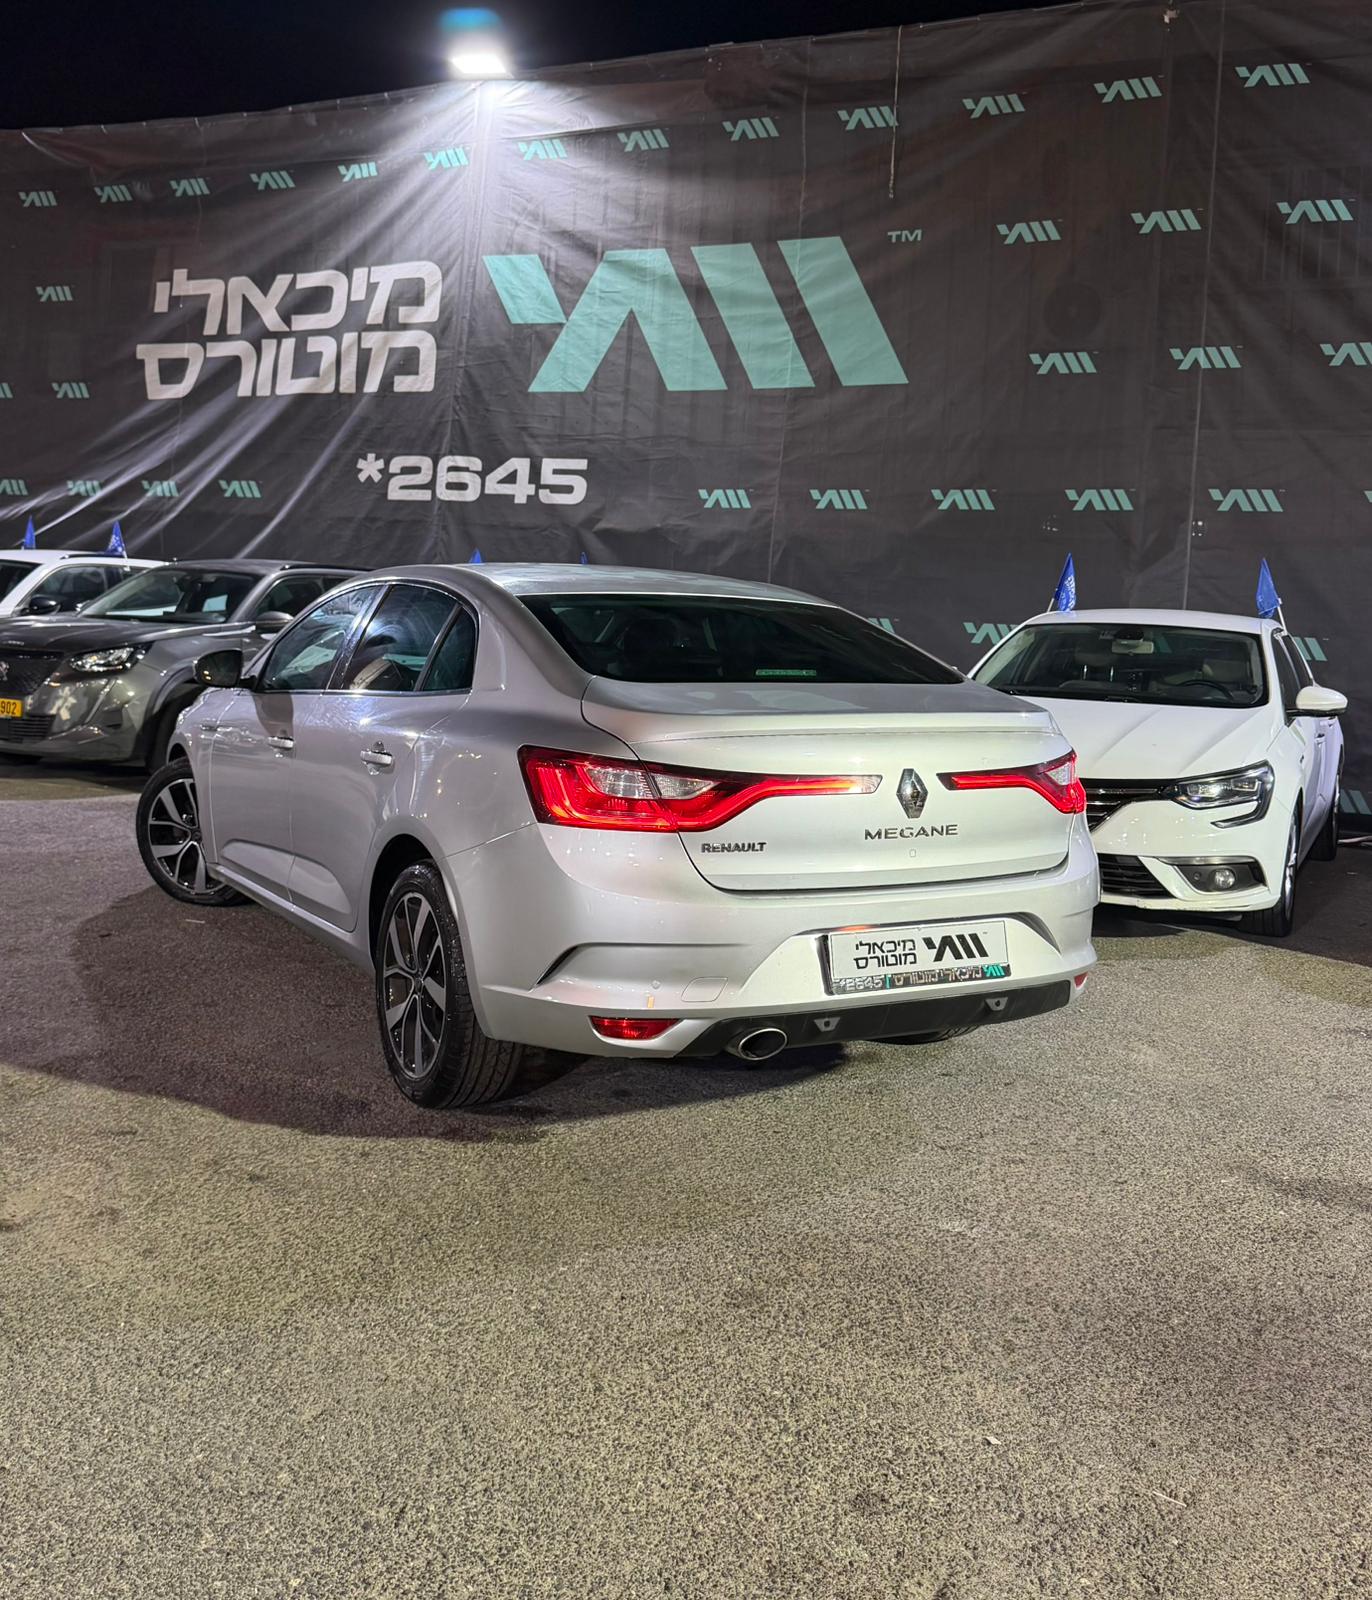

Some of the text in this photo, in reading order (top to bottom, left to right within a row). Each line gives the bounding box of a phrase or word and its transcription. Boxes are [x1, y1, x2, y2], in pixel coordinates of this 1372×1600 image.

[888, 229, 922, 243] TM
[154, 261, 443, 336] מיכאלי
[136, 330, 437, 400] מוטורס
[864, 824, 959, 840] MEGANE
[701, 841, 767, 853] RENAULT
[855, 939, 916, 955] מיכאלי
[853, 952, 917, 969] מוטורס
